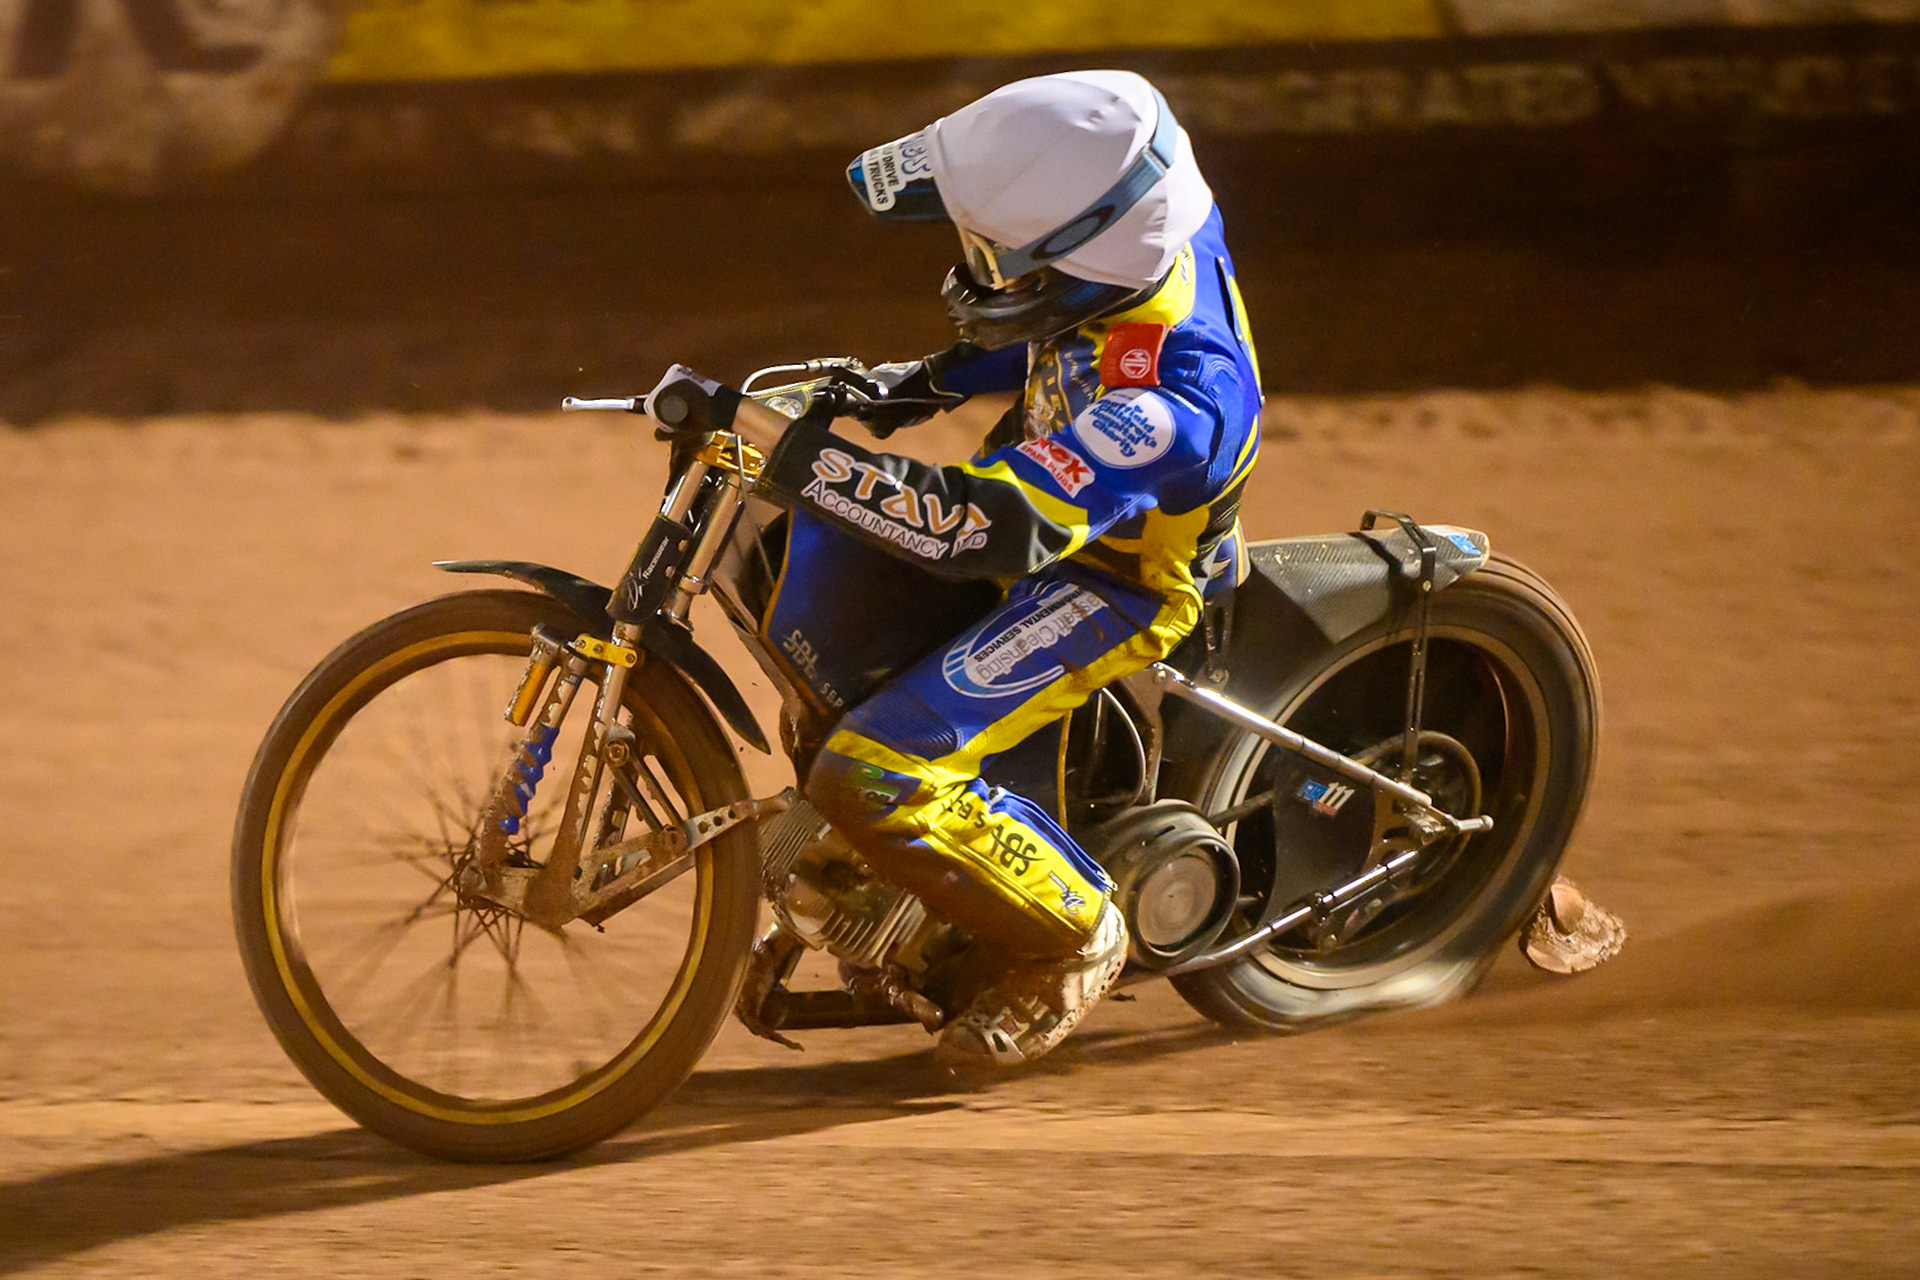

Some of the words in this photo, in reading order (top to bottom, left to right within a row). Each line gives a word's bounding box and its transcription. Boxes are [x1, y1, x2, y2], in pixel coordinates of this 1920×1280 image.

[868, 161, 888, 205] TRUCKS
[882, 155, 899, 187] DRIVE
[1092, 419, 1137, 457] Charity
[801, 478, 950, 560] ACCOUNTANCY
[974, 625, 1022, 662] SERVICES
[976, 626, 1057, 681] Cleansing
